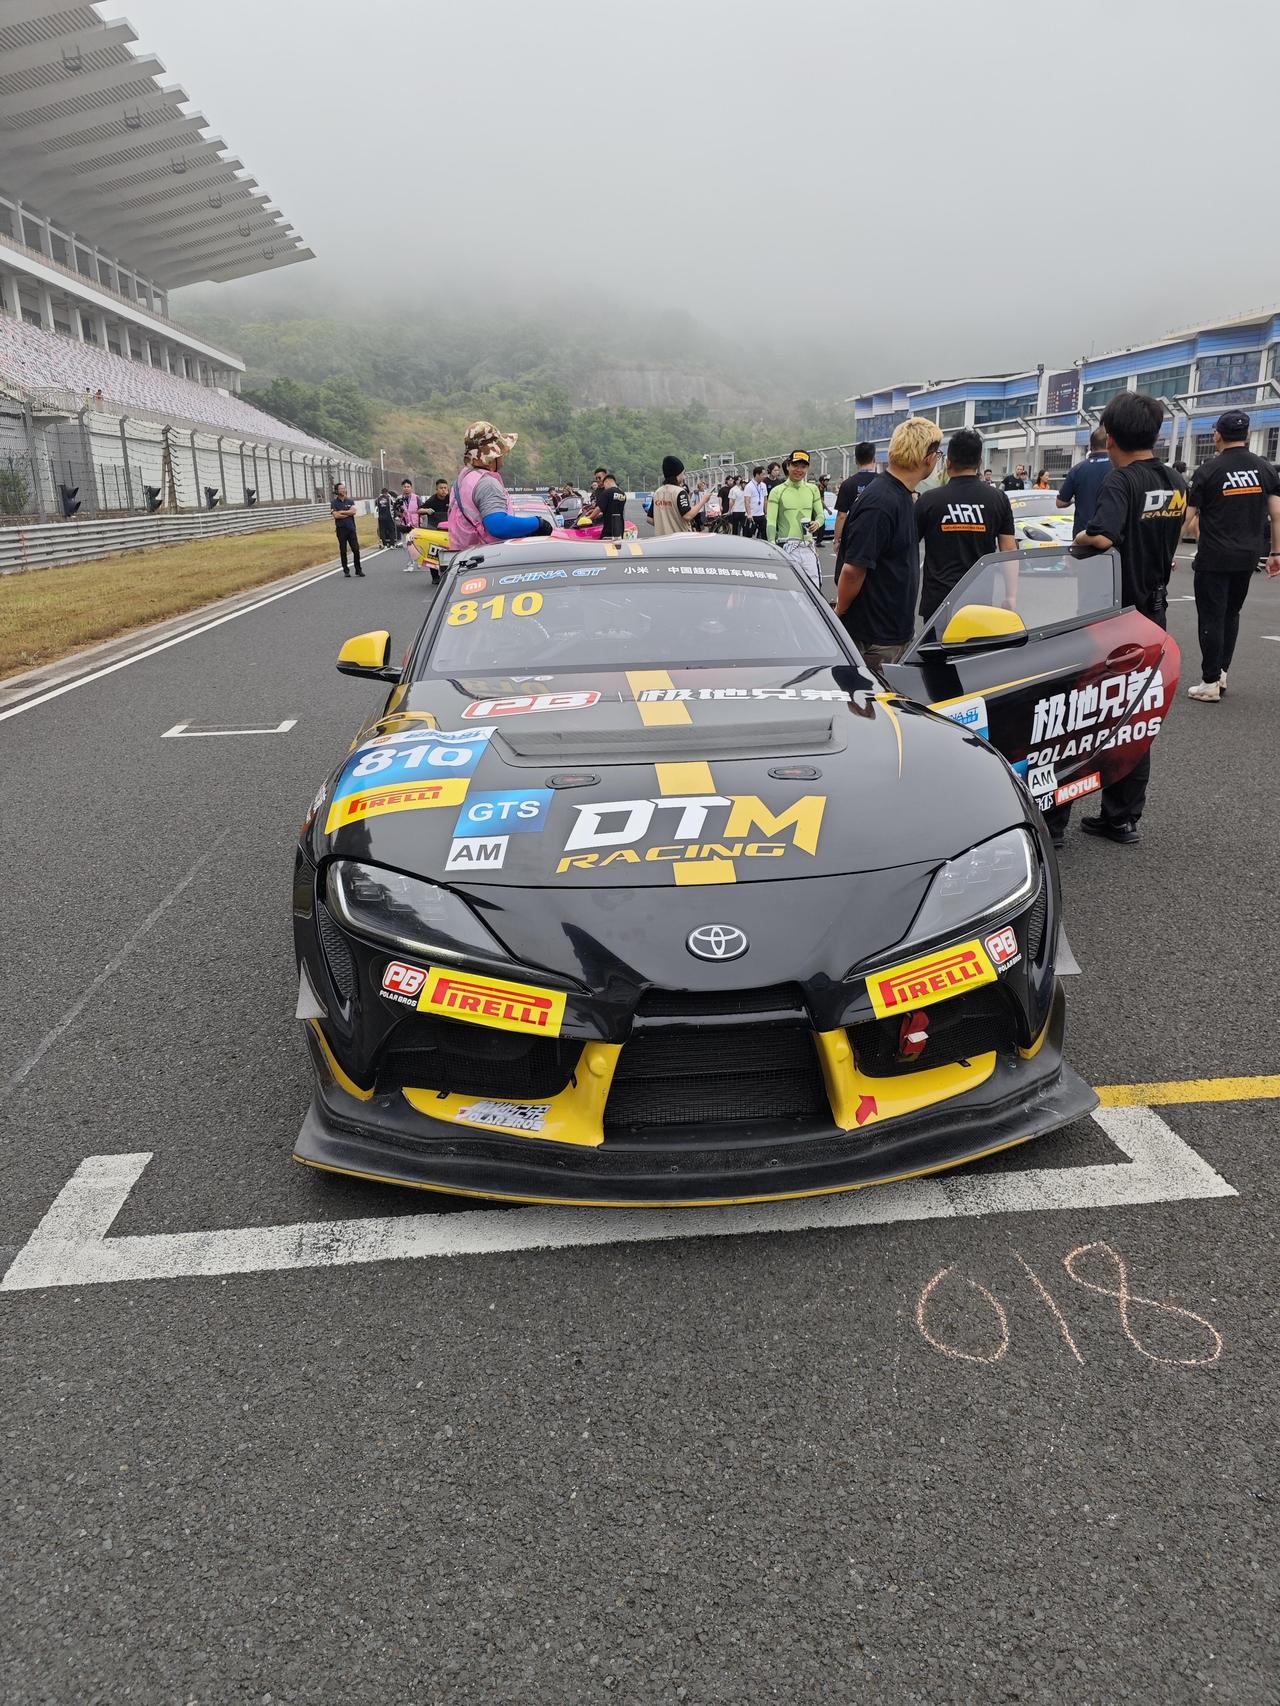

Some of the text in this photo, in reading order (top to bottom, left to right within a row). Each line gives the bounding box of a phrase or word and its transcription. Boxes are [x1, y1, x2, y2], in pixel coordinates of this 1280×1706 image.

[1144, 490, 1187, 514] DTM
[499, 569, 568, 585] CHINA
[571, 567, 607, 578] GT
[447, 591, 545, 627] 810
[1030, 666, 1165, 745] 极地兄弟
[352, 744, 473, 777] 810
[1031, 769, 1054, 789] AM
[1057, 775, 1099, 803] MOTUL
[348, 786, 443, 815] PIRELLI
[468, 800, 541, 822] GTS
[563, 795, 827, 856] DTM
[451, 843, 502, 862] AM
[555, 842, 786, 874] RACING
[987, 929, 1016, 961] PB
[384, 964, 425, 993] PB
[878, 950, 984, 1009] PIRELLI
[430, 977, 553, 1027] PIRELLI
[915, 1241, 1223, 1366] 018
